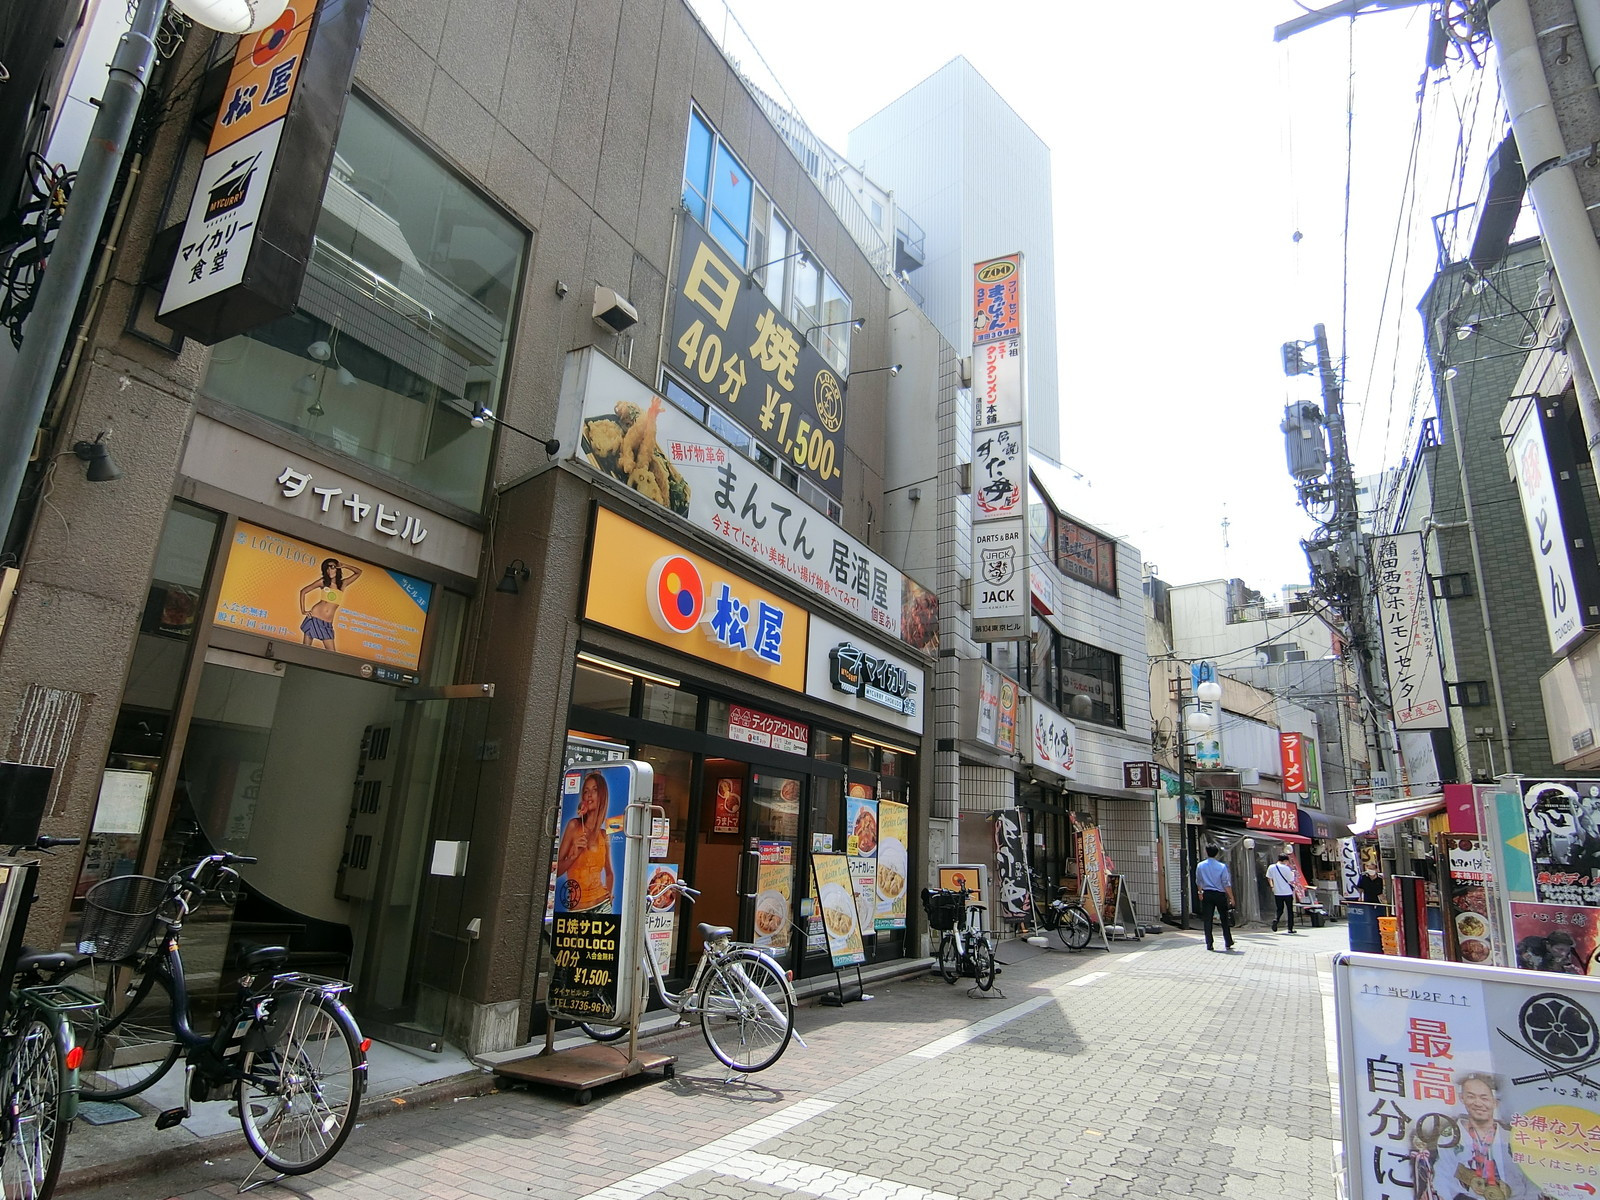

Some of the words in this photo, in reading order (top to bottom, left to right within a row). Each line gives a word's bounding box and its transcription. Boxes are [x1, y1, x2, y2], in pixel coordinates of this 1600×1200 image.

[222, 55, 299, 127] 松屋
[209, 189, 245, 213] MYCURRY
[182, 221, 254, 263] マイカリー
[187, 249, 229, 285] 食堂
[982, 264, 1011, 280] ZOO
[977, 288, 985, 307] 3F
[1008, 339, 1019, 357] 元祖
[677, 319, 748, 404] 40分
[986, 345, 997, 424] タンタンメン本舗
[671, 442, 726, 465] 揚げ物革命
[277, 466, 428, 546] ダイヤビル
[714, 462, 815, 560] まんてん
[829, 539, 889, 611] 居酒屋
[976, 533, 999, 544] DARTS
[1004, 531, 1019, 541] BAR
[982, 589, 1015, 604] JACK
[709, 582, 785, 666] 松屋
[1380, 541, 1415, 712] 蒲田西口ホルモンセンター
[864, 653, 917, 697] マイカリー
[752, 714, 808, 742] テイクアウトOK!
[1282, 735, 1303, 791] ラーメン
[716, 816, 739, 827] うまトマ
[556, 918, 616, 936] 日焼サロン
[556, 937, 584, 949] LOCO
[585, 939, 615, 950] LOCO
[555, 949, 580, 968] 40分
[585, 951, 614, 961] 入会金無料
[1388, 986, 1442, 1002] 当ビル2F
[1366, 1054, 1415, 1200] 自分に
[1513, 1152, 1598, 1177] 詳しくはこちら
